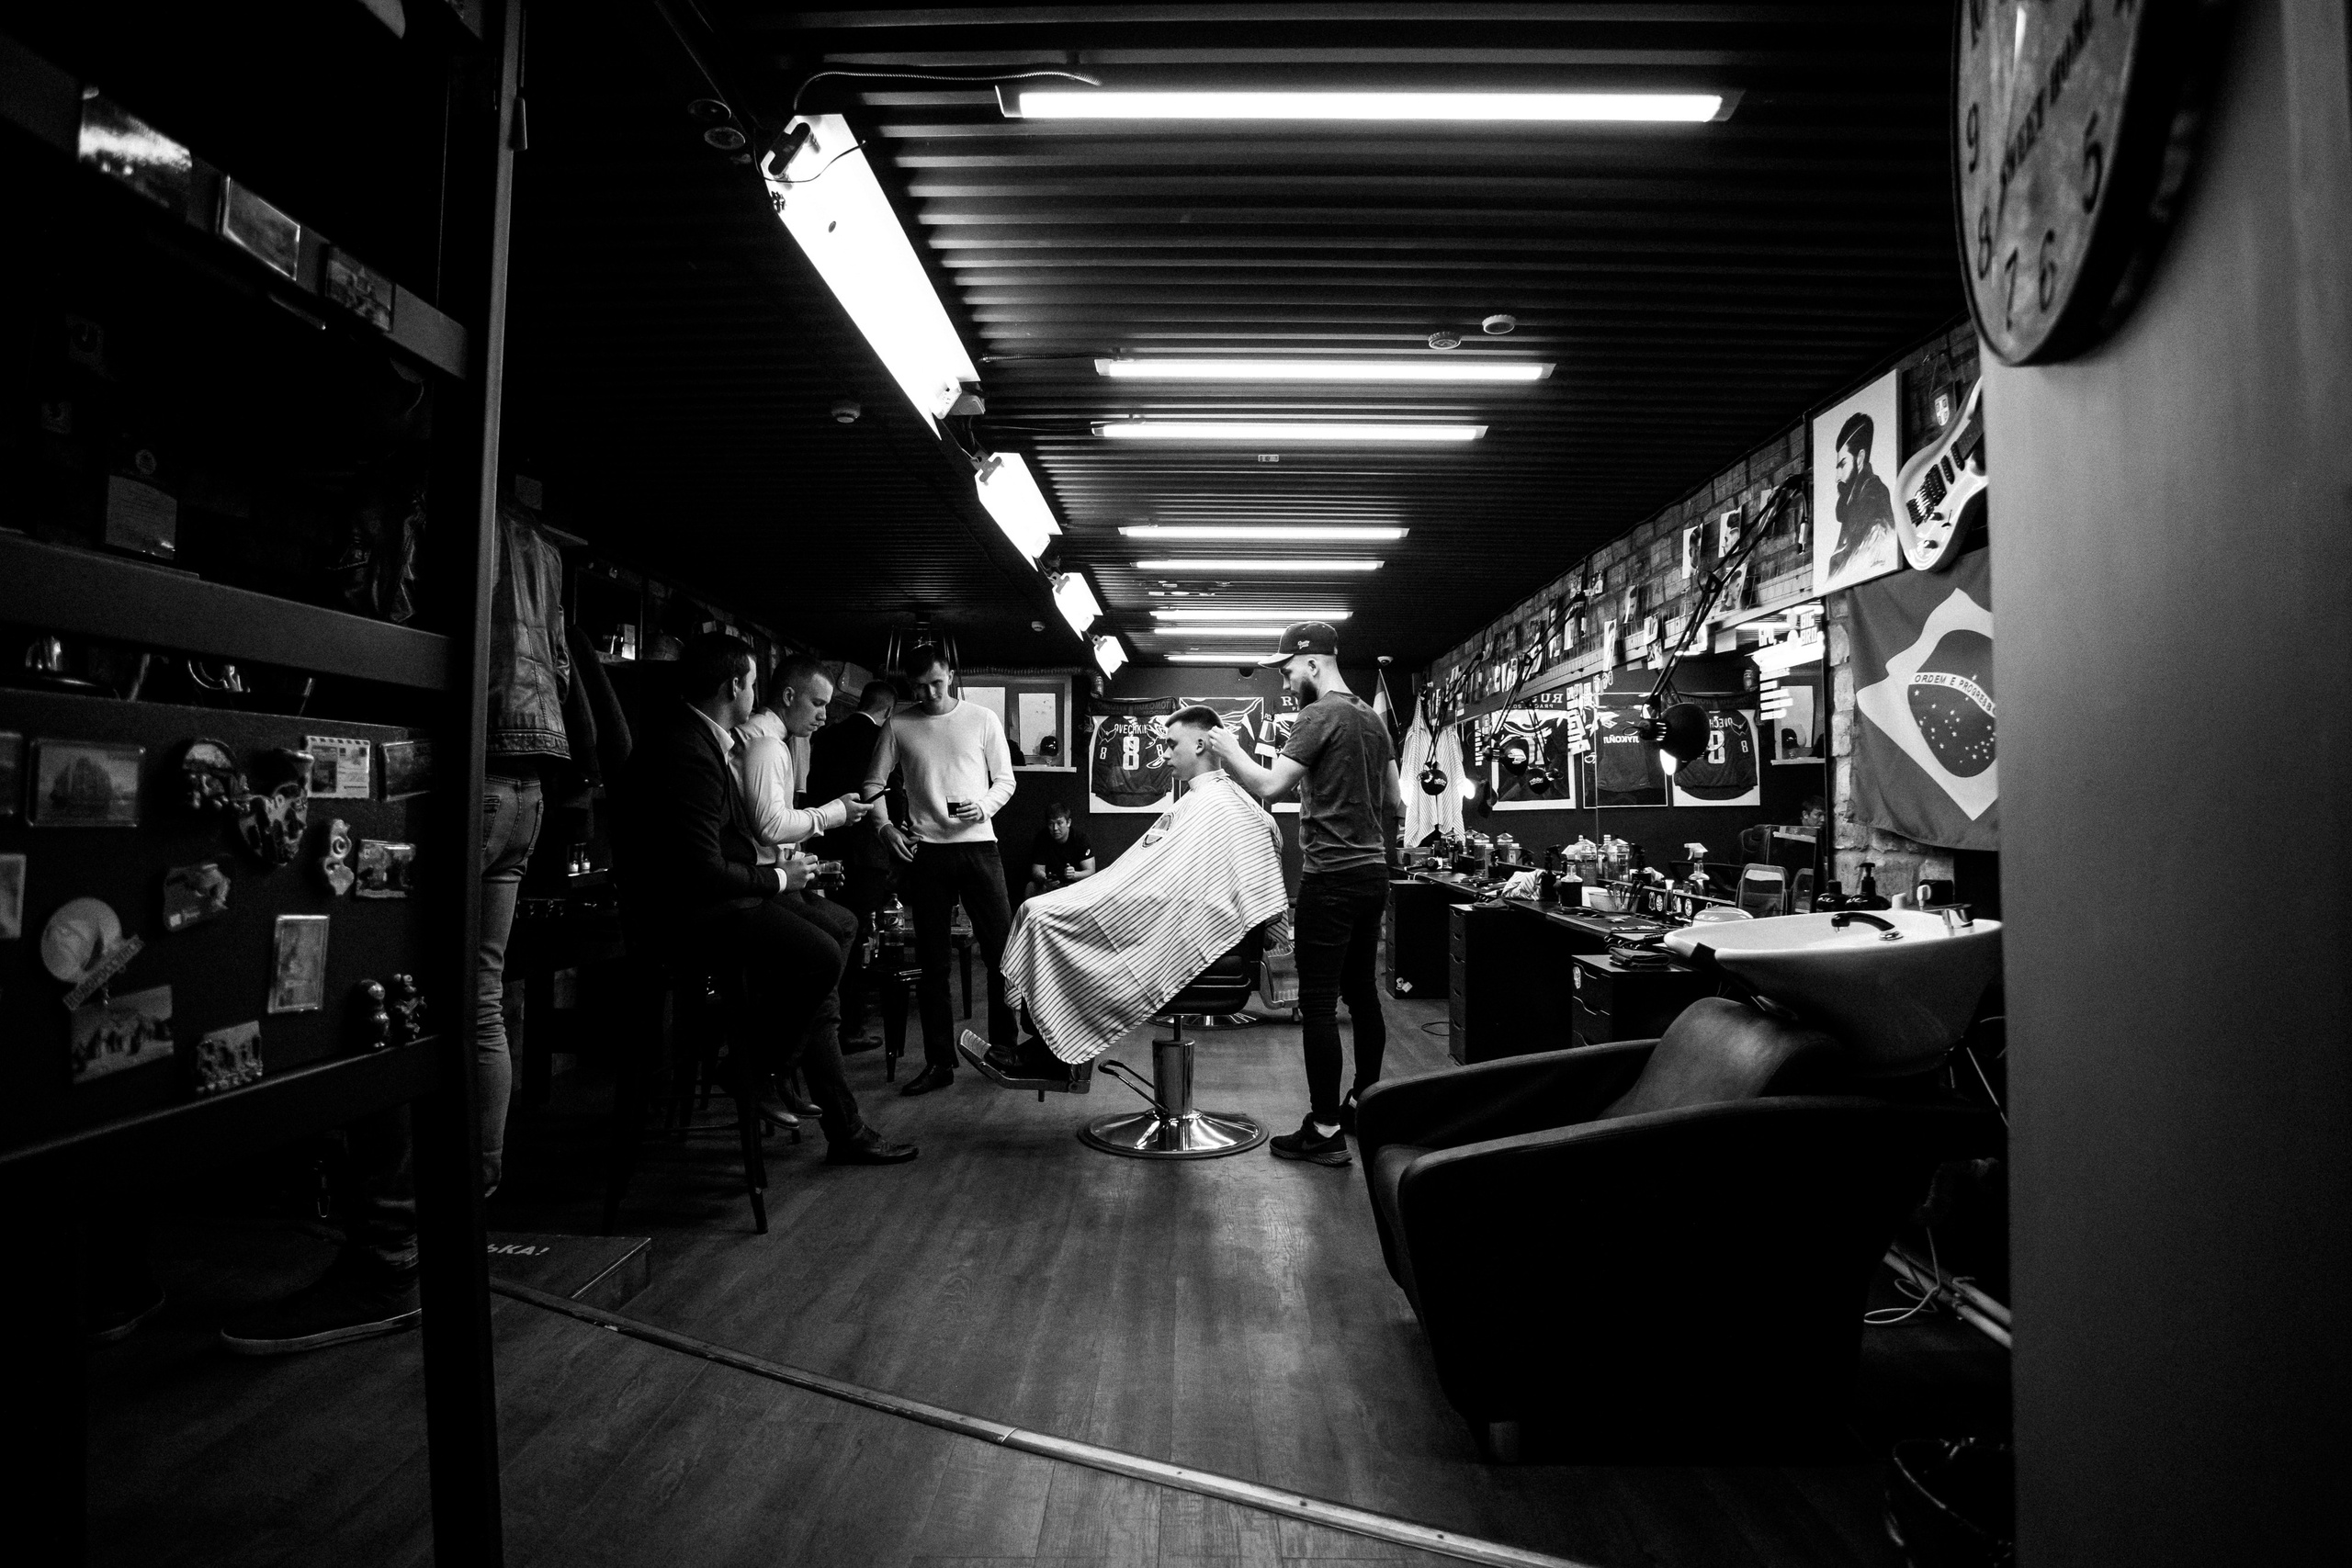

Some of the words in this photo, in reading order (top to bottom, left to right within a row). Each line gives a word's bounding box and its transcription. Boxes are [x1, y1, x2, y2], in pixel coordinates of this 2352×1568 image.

[1966, 103, 1979, 174] 9
[2081, 109, 2102, 215] 5
[1977, 204, 1992, 281] 8
[2039, 230, 2055, 314] 6
[2005, 245, 2018, 333] 7
[1914, 674, 1947, 683] ORDEM
[1949, 677, 1957, 686] E
[1959, 679, 1996, 713] PROGRESS
[1099, 746, 1108, 760] 8
[1123, 736, 1139, 771] 8
[1156, 743, 1164, 758] 8
